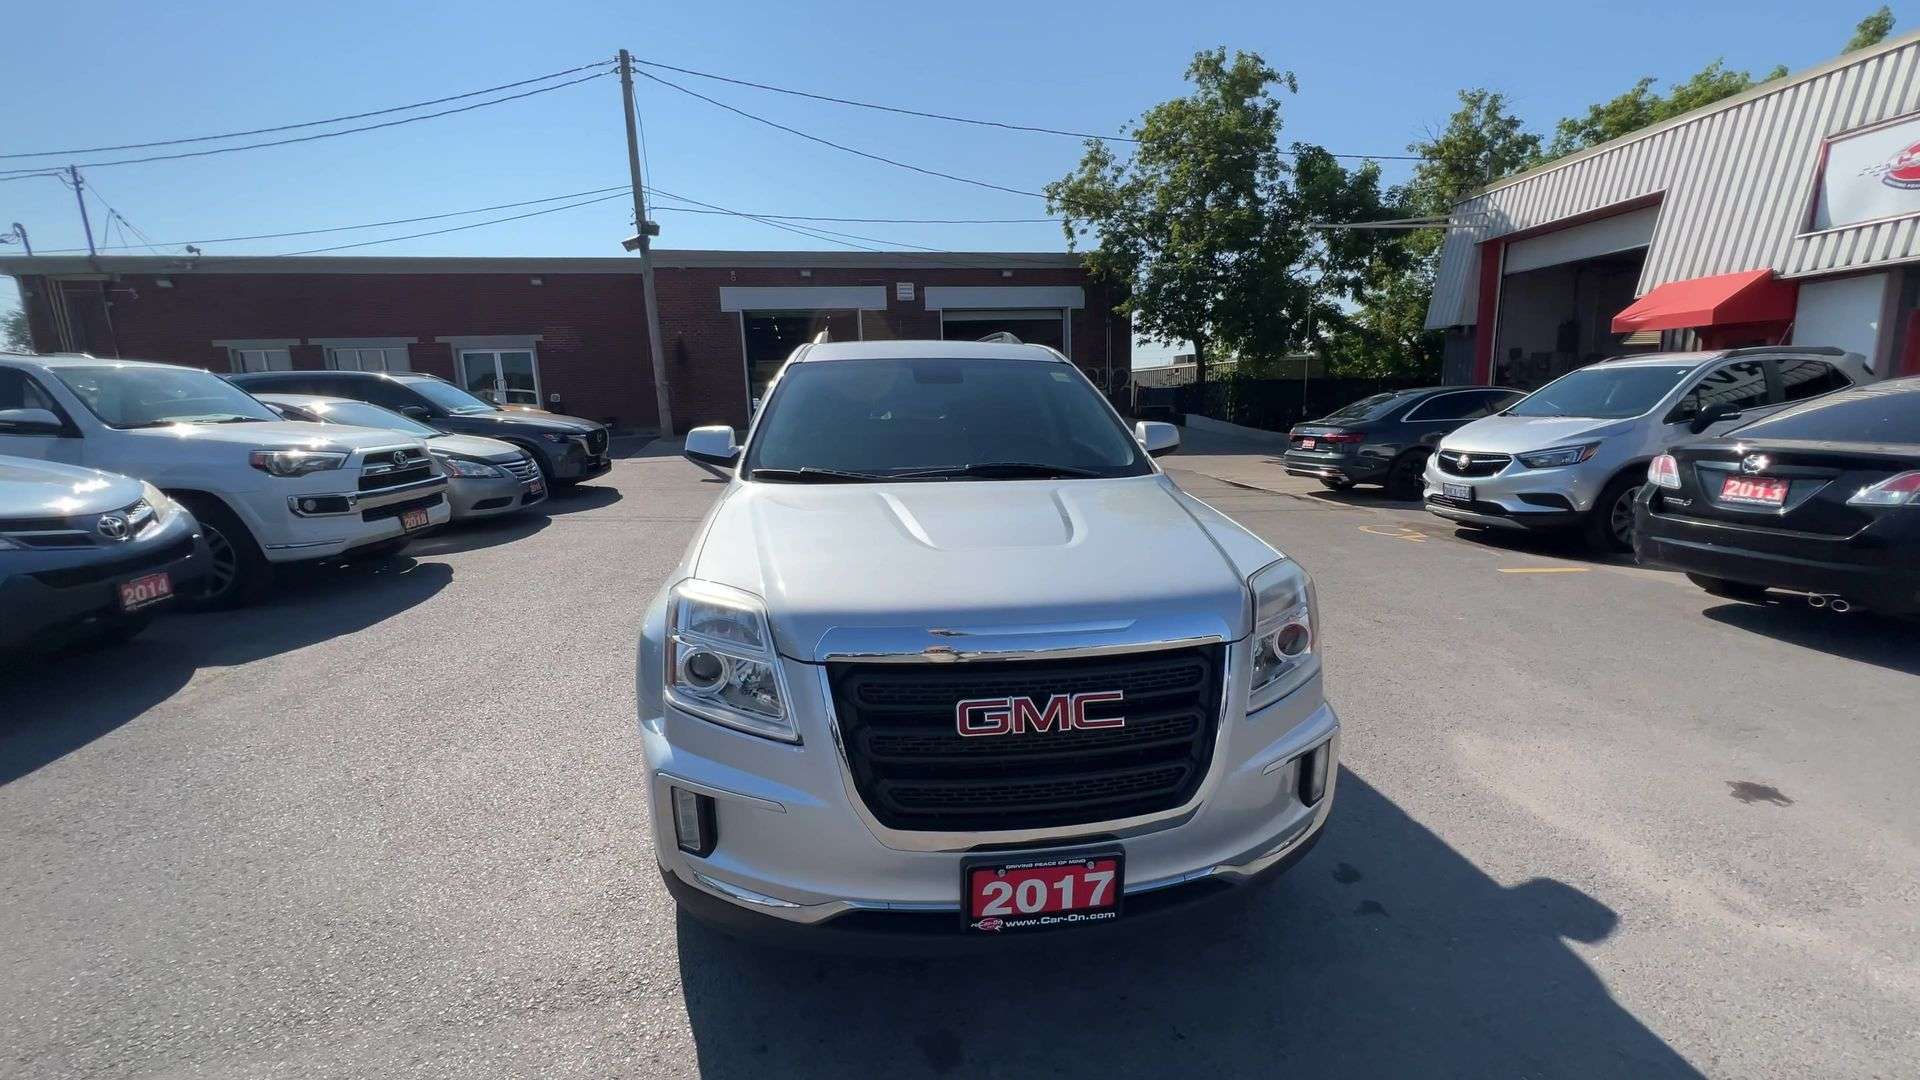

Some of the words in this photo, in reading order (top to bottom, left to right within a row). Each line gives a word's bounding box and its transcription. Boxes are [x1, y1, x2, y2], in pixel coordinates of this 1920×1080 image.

[124, 578, 168, 606] 2014
[956, 690, 1125, 737] GMC
[982, 870, 1115, 917] 2017
[1005, 912, 1116, 928] www.Car-On.com
